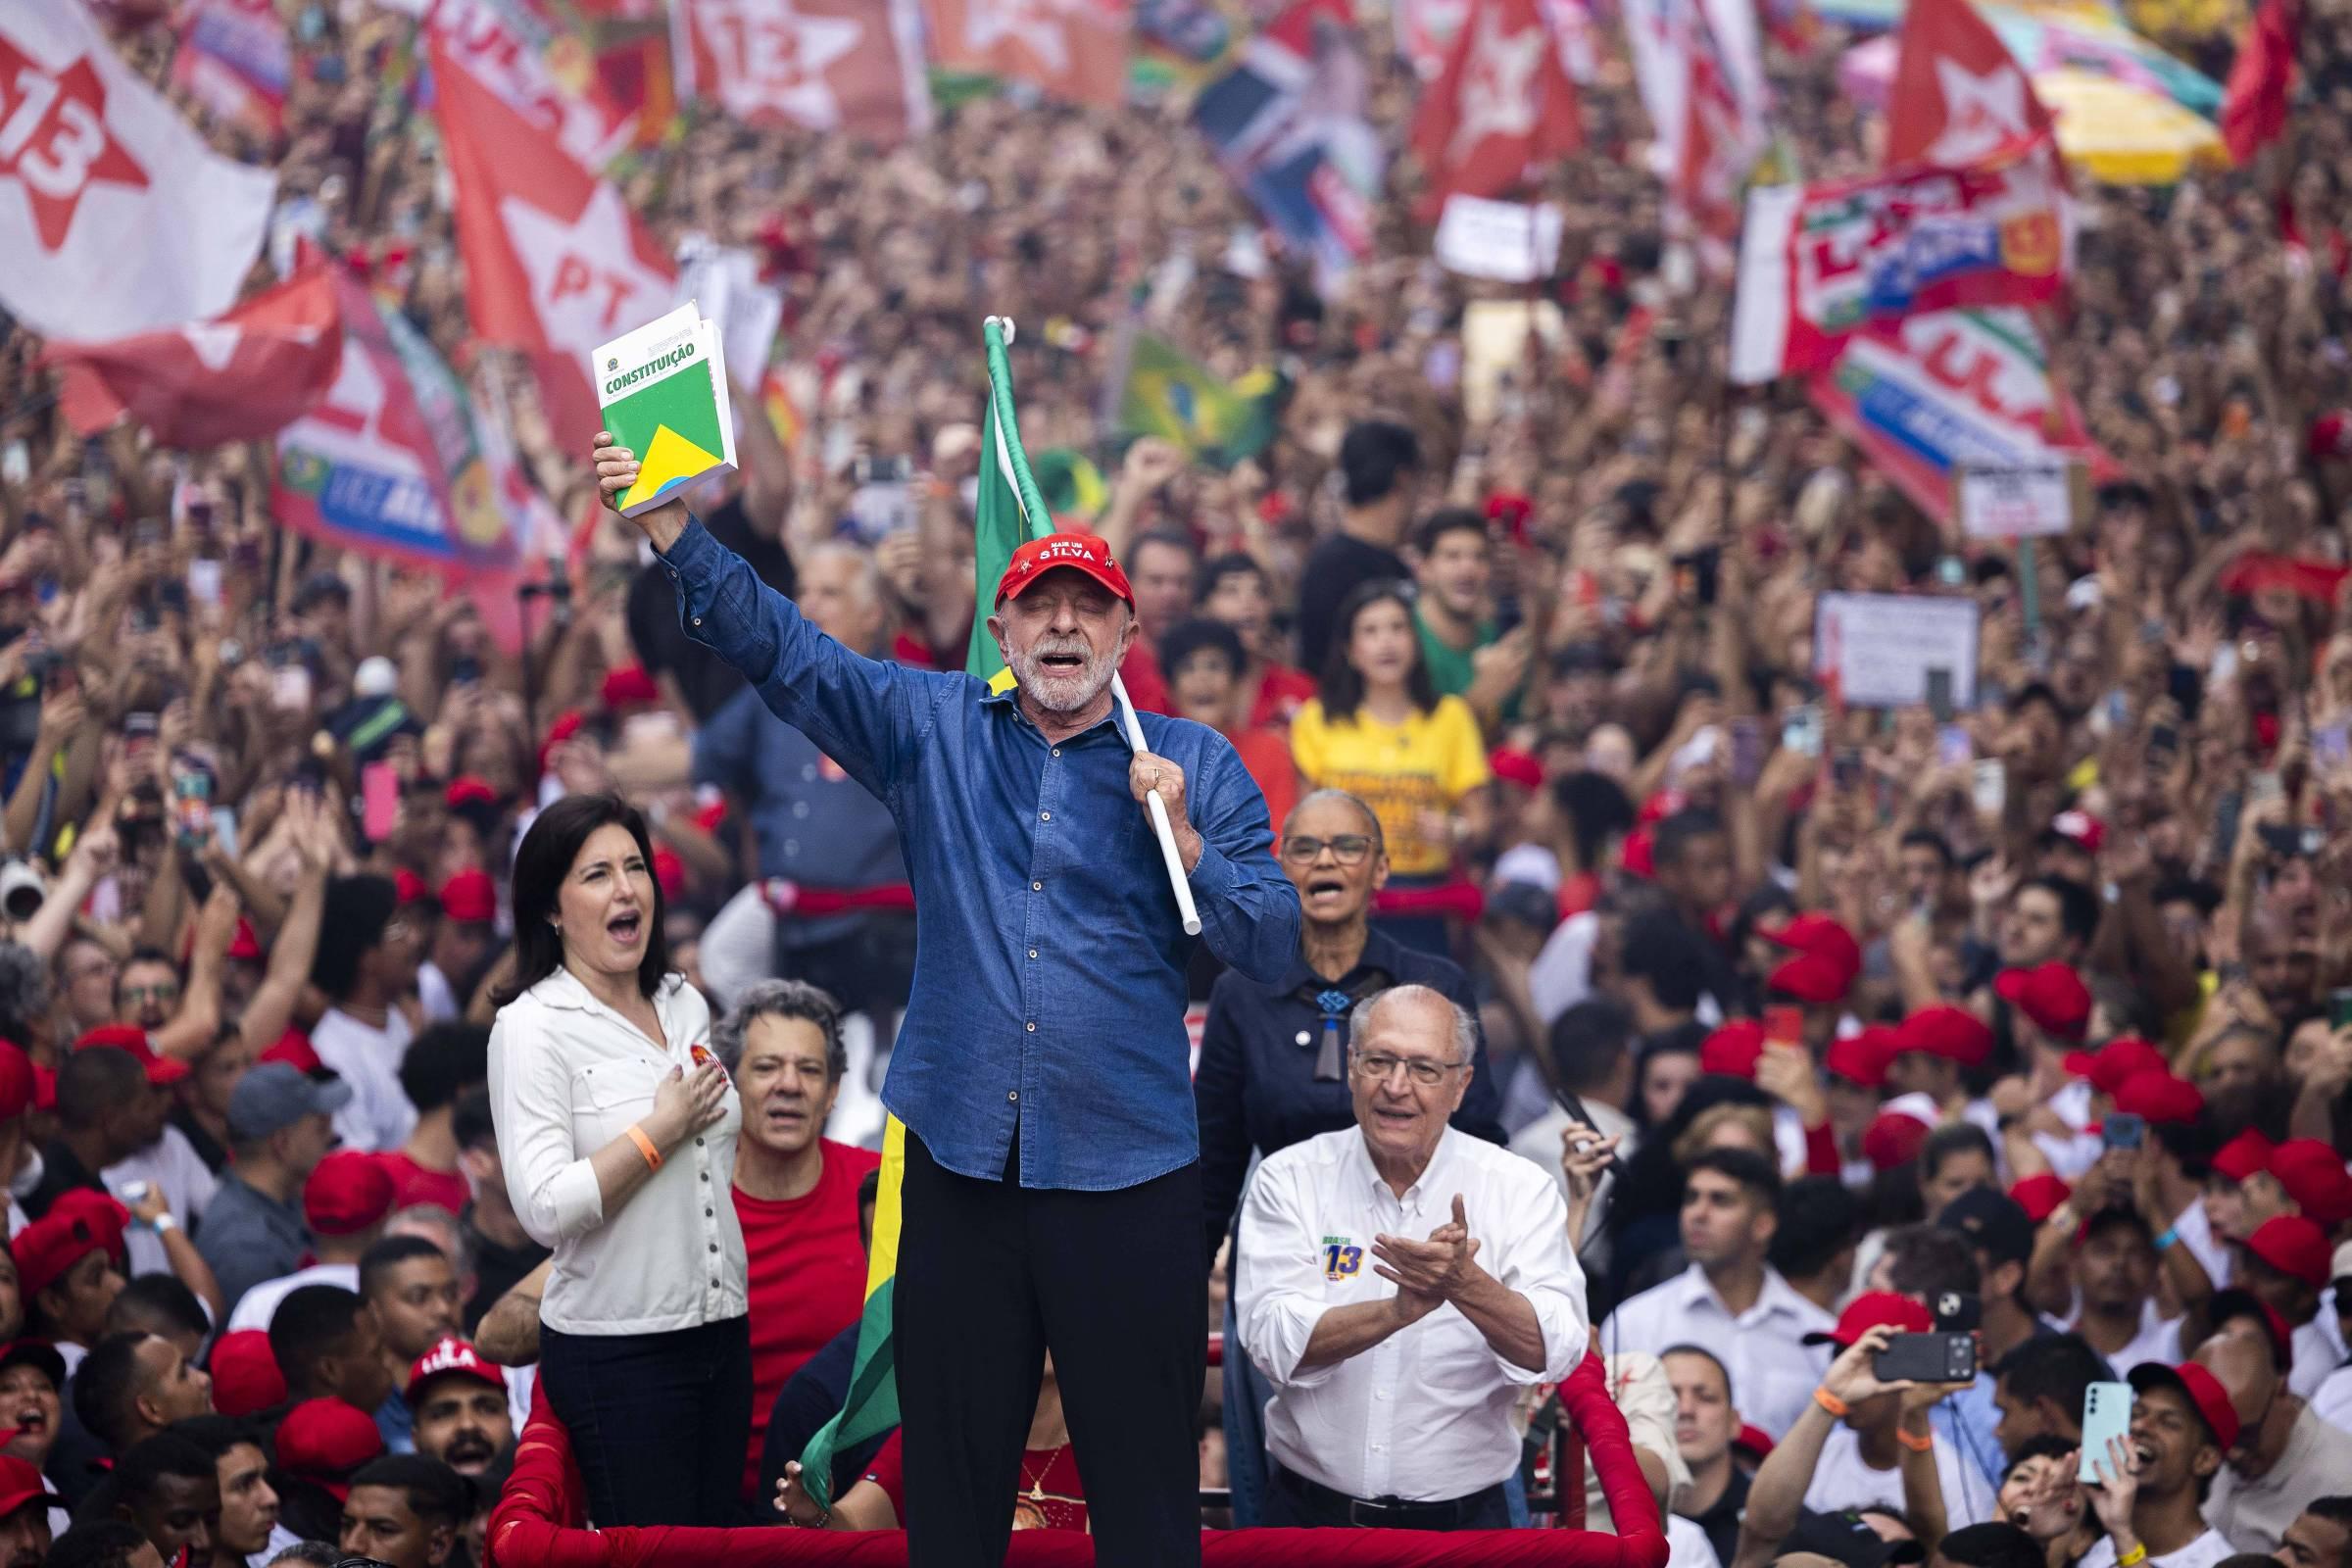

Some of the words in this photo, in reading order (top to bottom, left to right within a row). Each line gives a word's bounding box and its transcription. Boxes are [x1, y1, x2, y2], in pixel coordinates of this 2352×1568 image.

[0, 69, 105, 199] 13
[553, 255, 634, 329] PT
[606, 342, 695, 395] CONSTITUIÇÃO
[1040, 547, 1095, 562] SILVA
[1327, 1245, 1362, 1274] 13
